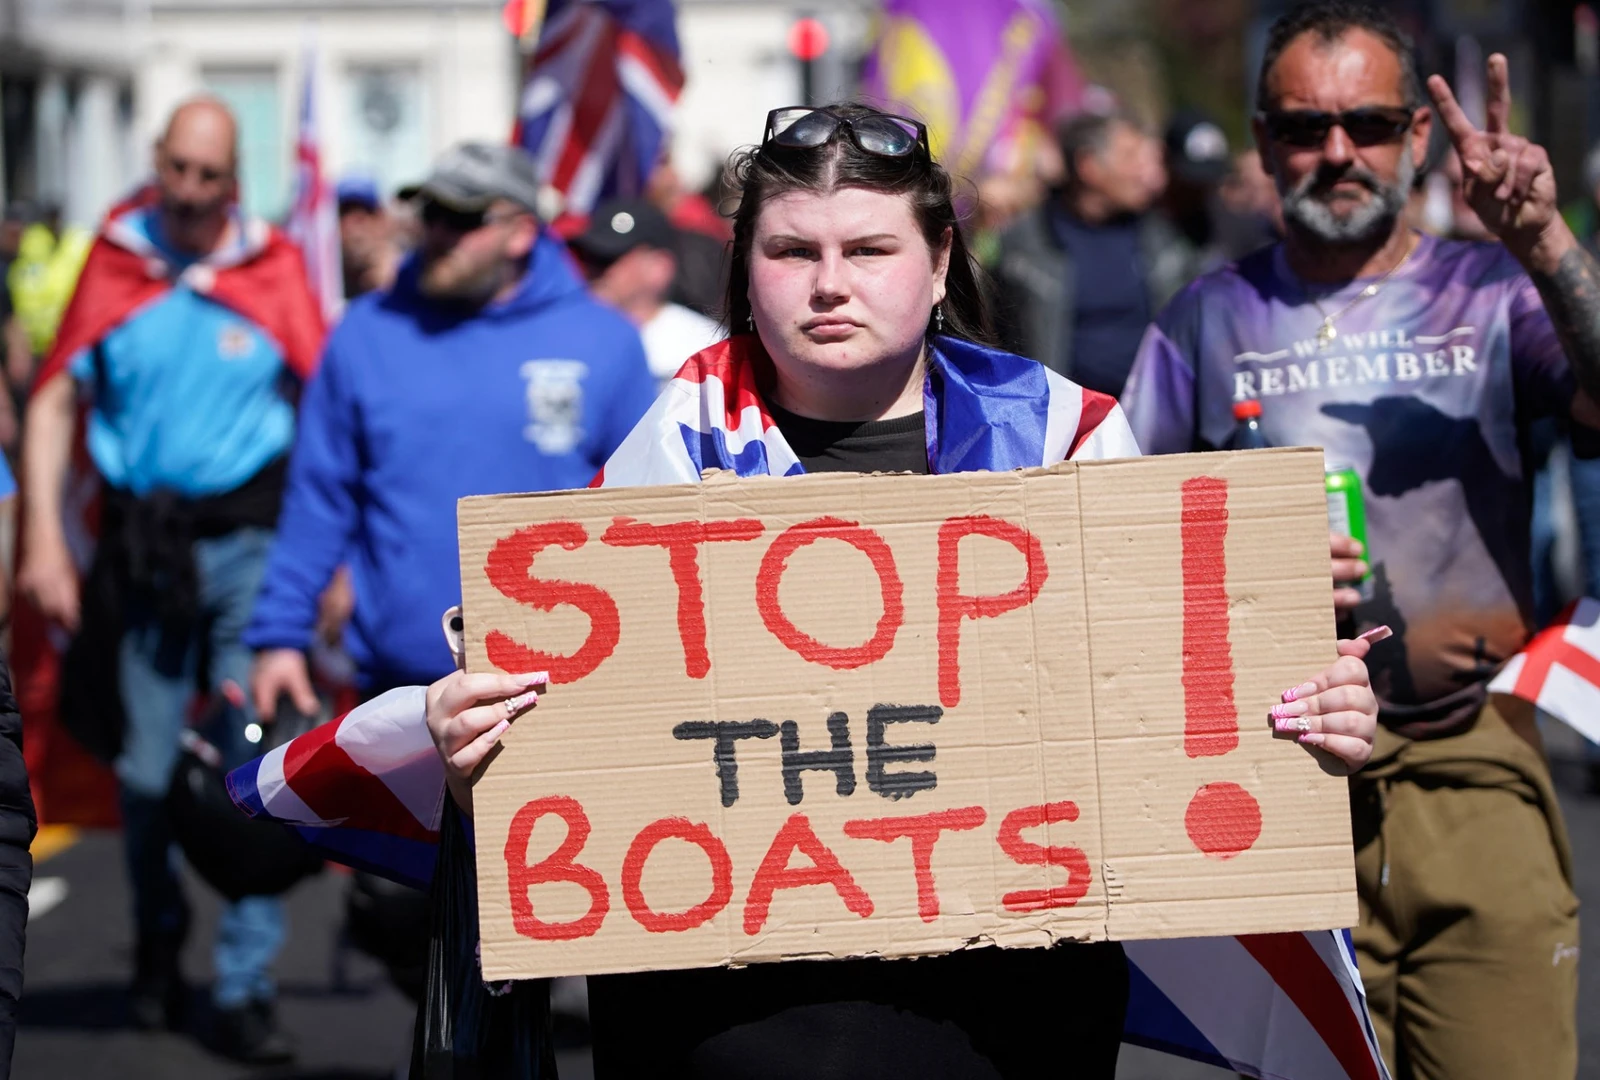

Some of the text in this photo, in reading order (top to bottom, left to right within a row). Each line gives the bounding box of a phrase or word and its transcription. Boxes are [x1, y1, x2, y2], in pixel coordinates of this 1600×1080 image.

[1233, 345, 1478, 400] REMEMBER
[1342, 330, 1413, 349] WILL
[484, 515, 1049, 708] STOP
[672, 703, 944, 808] THE
[504, 795, 1092, 941] BOATS
